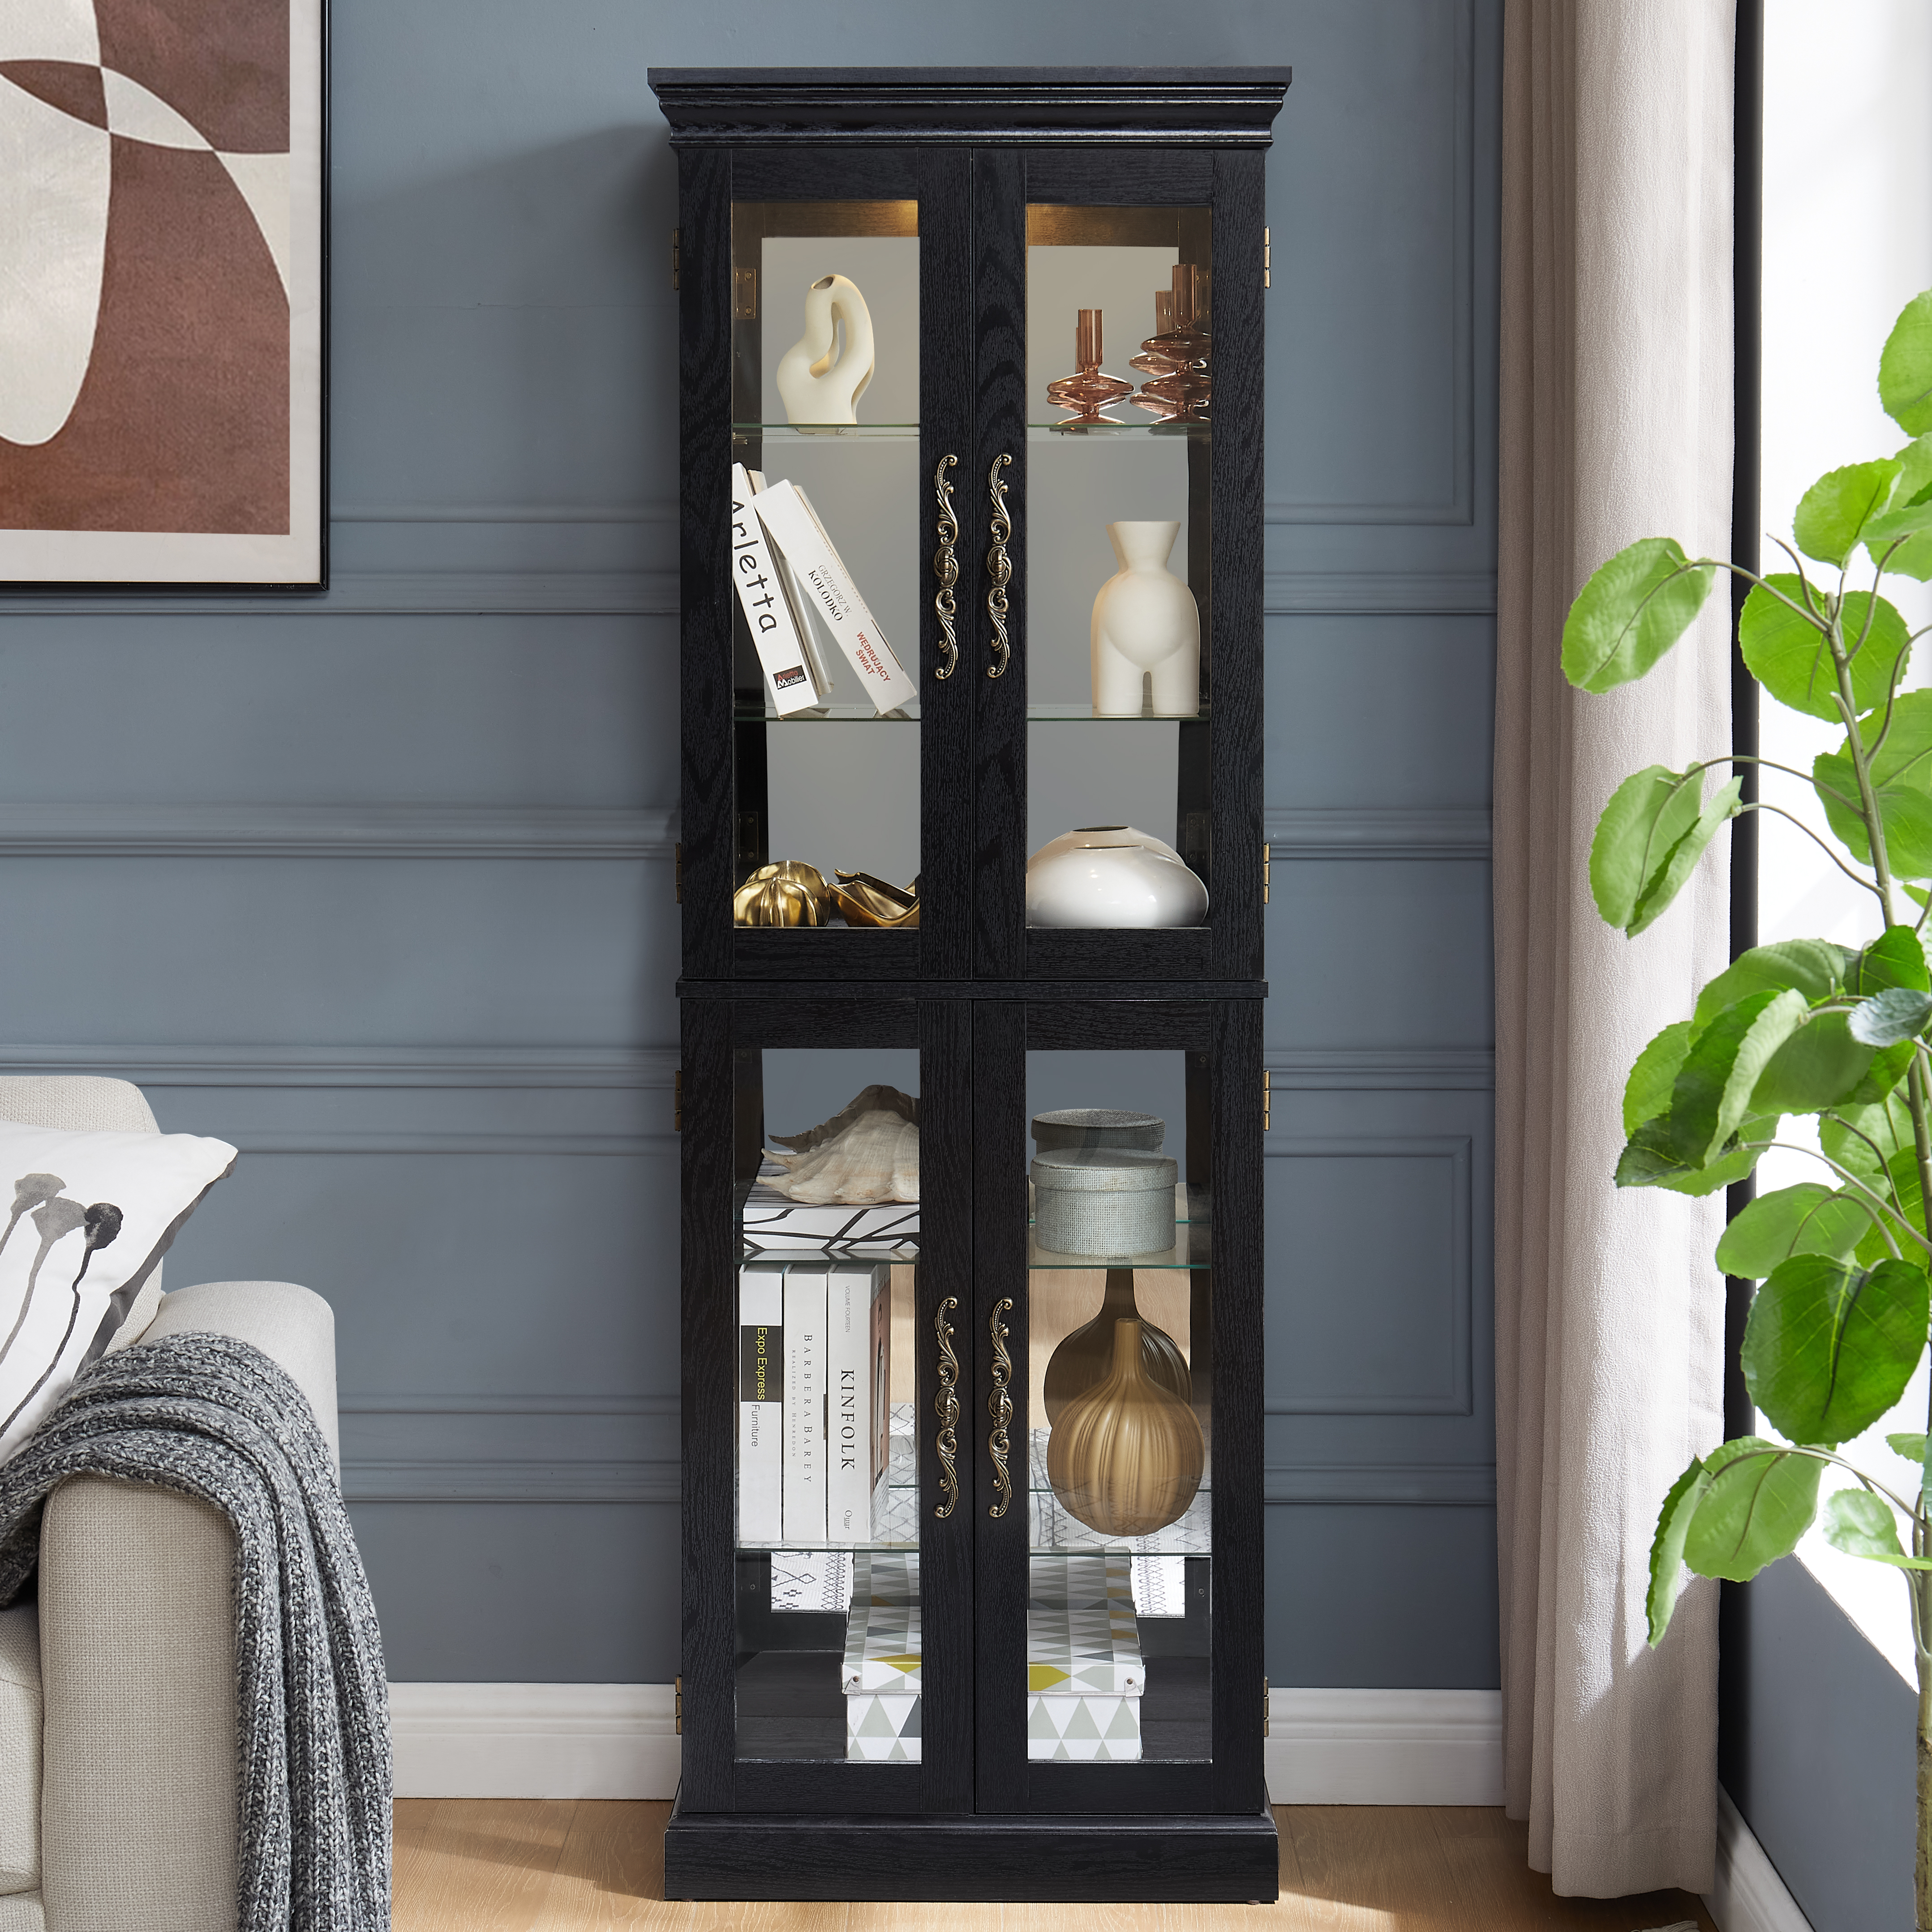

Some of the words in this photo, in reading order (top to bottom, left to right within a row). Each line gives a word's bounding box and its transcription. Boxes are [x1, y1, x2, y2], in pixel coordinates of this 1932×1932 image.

[808, 570, 843, 621] KOLODKO
[818, 565, 847, 606] GRZEGORZ
[843, 605, 852, 617] W.
[856, 649, 875, 674] ŚWIAT
[857, 631, 891, 681] WĘDRUJĄCY
[777, 675, 804, 689] Mobilier
[755, 1327, 768, 1354] Expo
[755, 1357, 768, 1400] Express
[804, 1334, 812, 1417] BARBERA
[792, 1397, 796, 1406] BY
[841, 1369, 855, 1470] KINFOLK
[751, 1404, 760, 1447] Furniture
[804, 1427, 812, 1482] BAREY
[844, 1510, 852, 1530] Ouur
